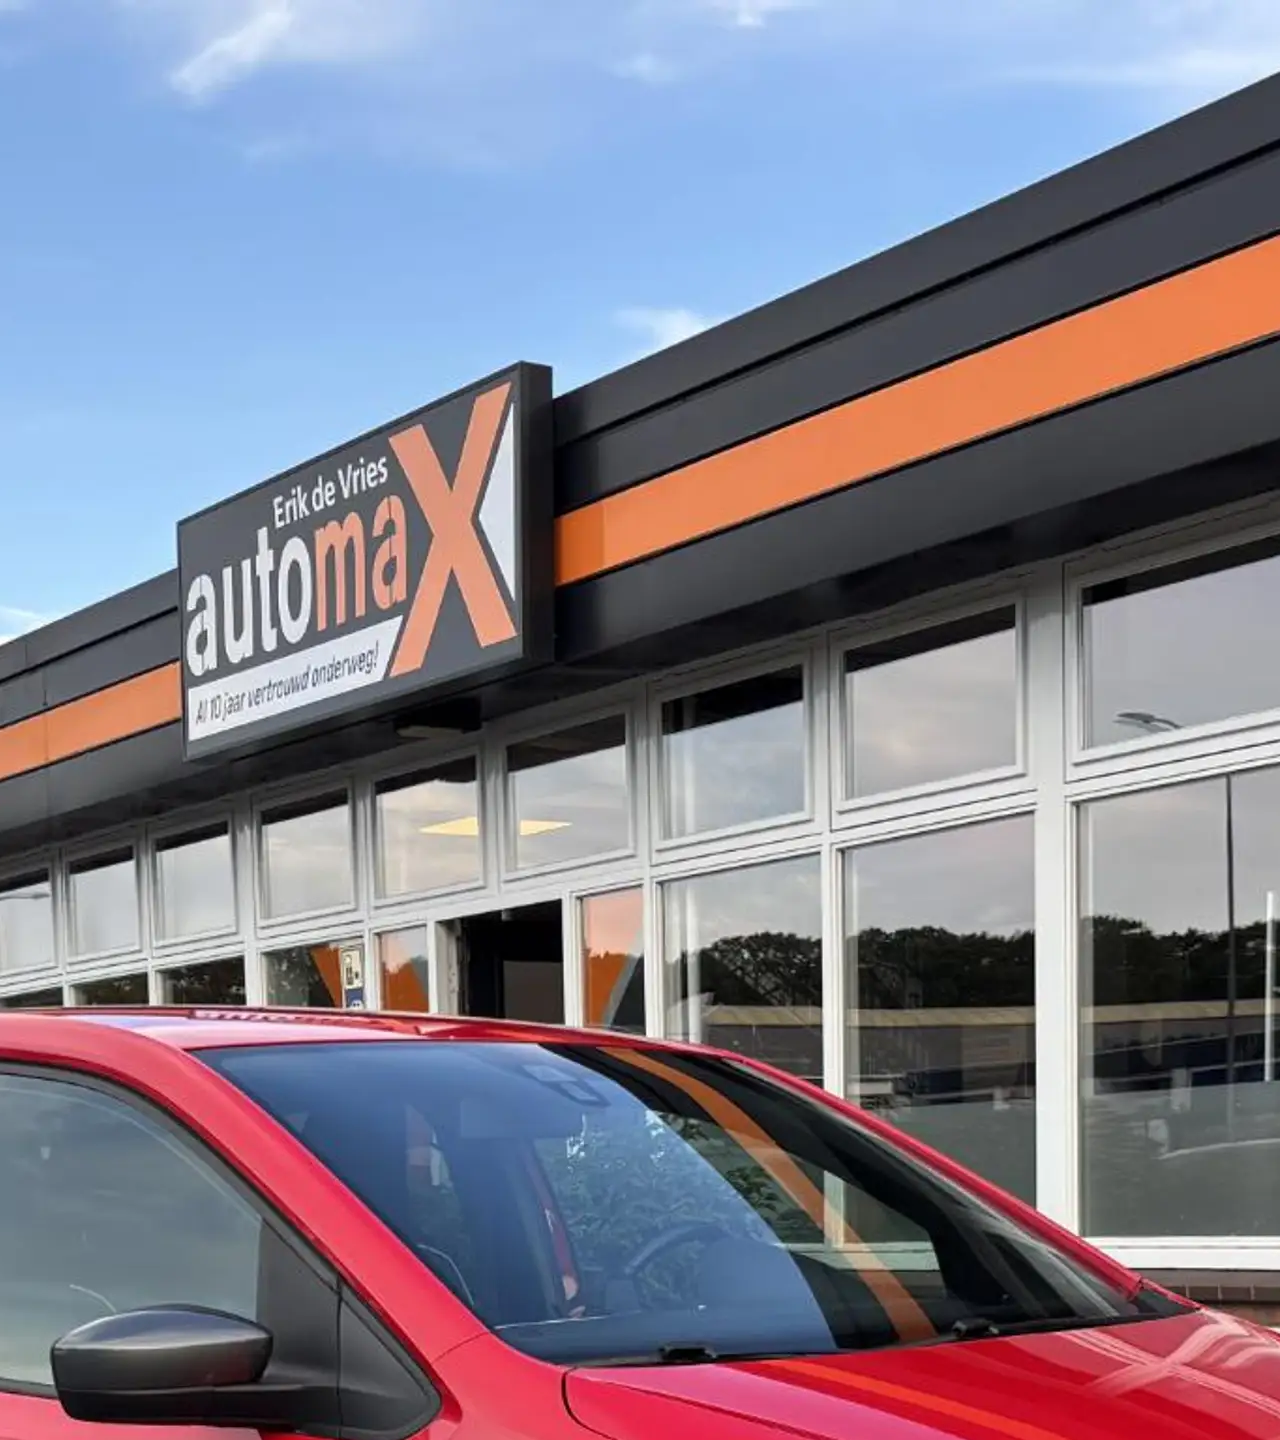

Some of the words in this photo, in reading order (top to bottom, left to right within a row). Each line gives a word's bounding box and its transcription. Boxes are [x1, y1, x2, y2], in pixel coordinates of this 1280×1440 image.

[273, 485, 310, 528] Erik
[312, 475, 336, 512] de
[337, 457, 388, 499] Vries
[209, 693, 221, 721] 10
[222, 691, 246, 721] jaar
[247, 664, 311, 708] vertrouwd
[311, 640, 379, 688] onderweg!
